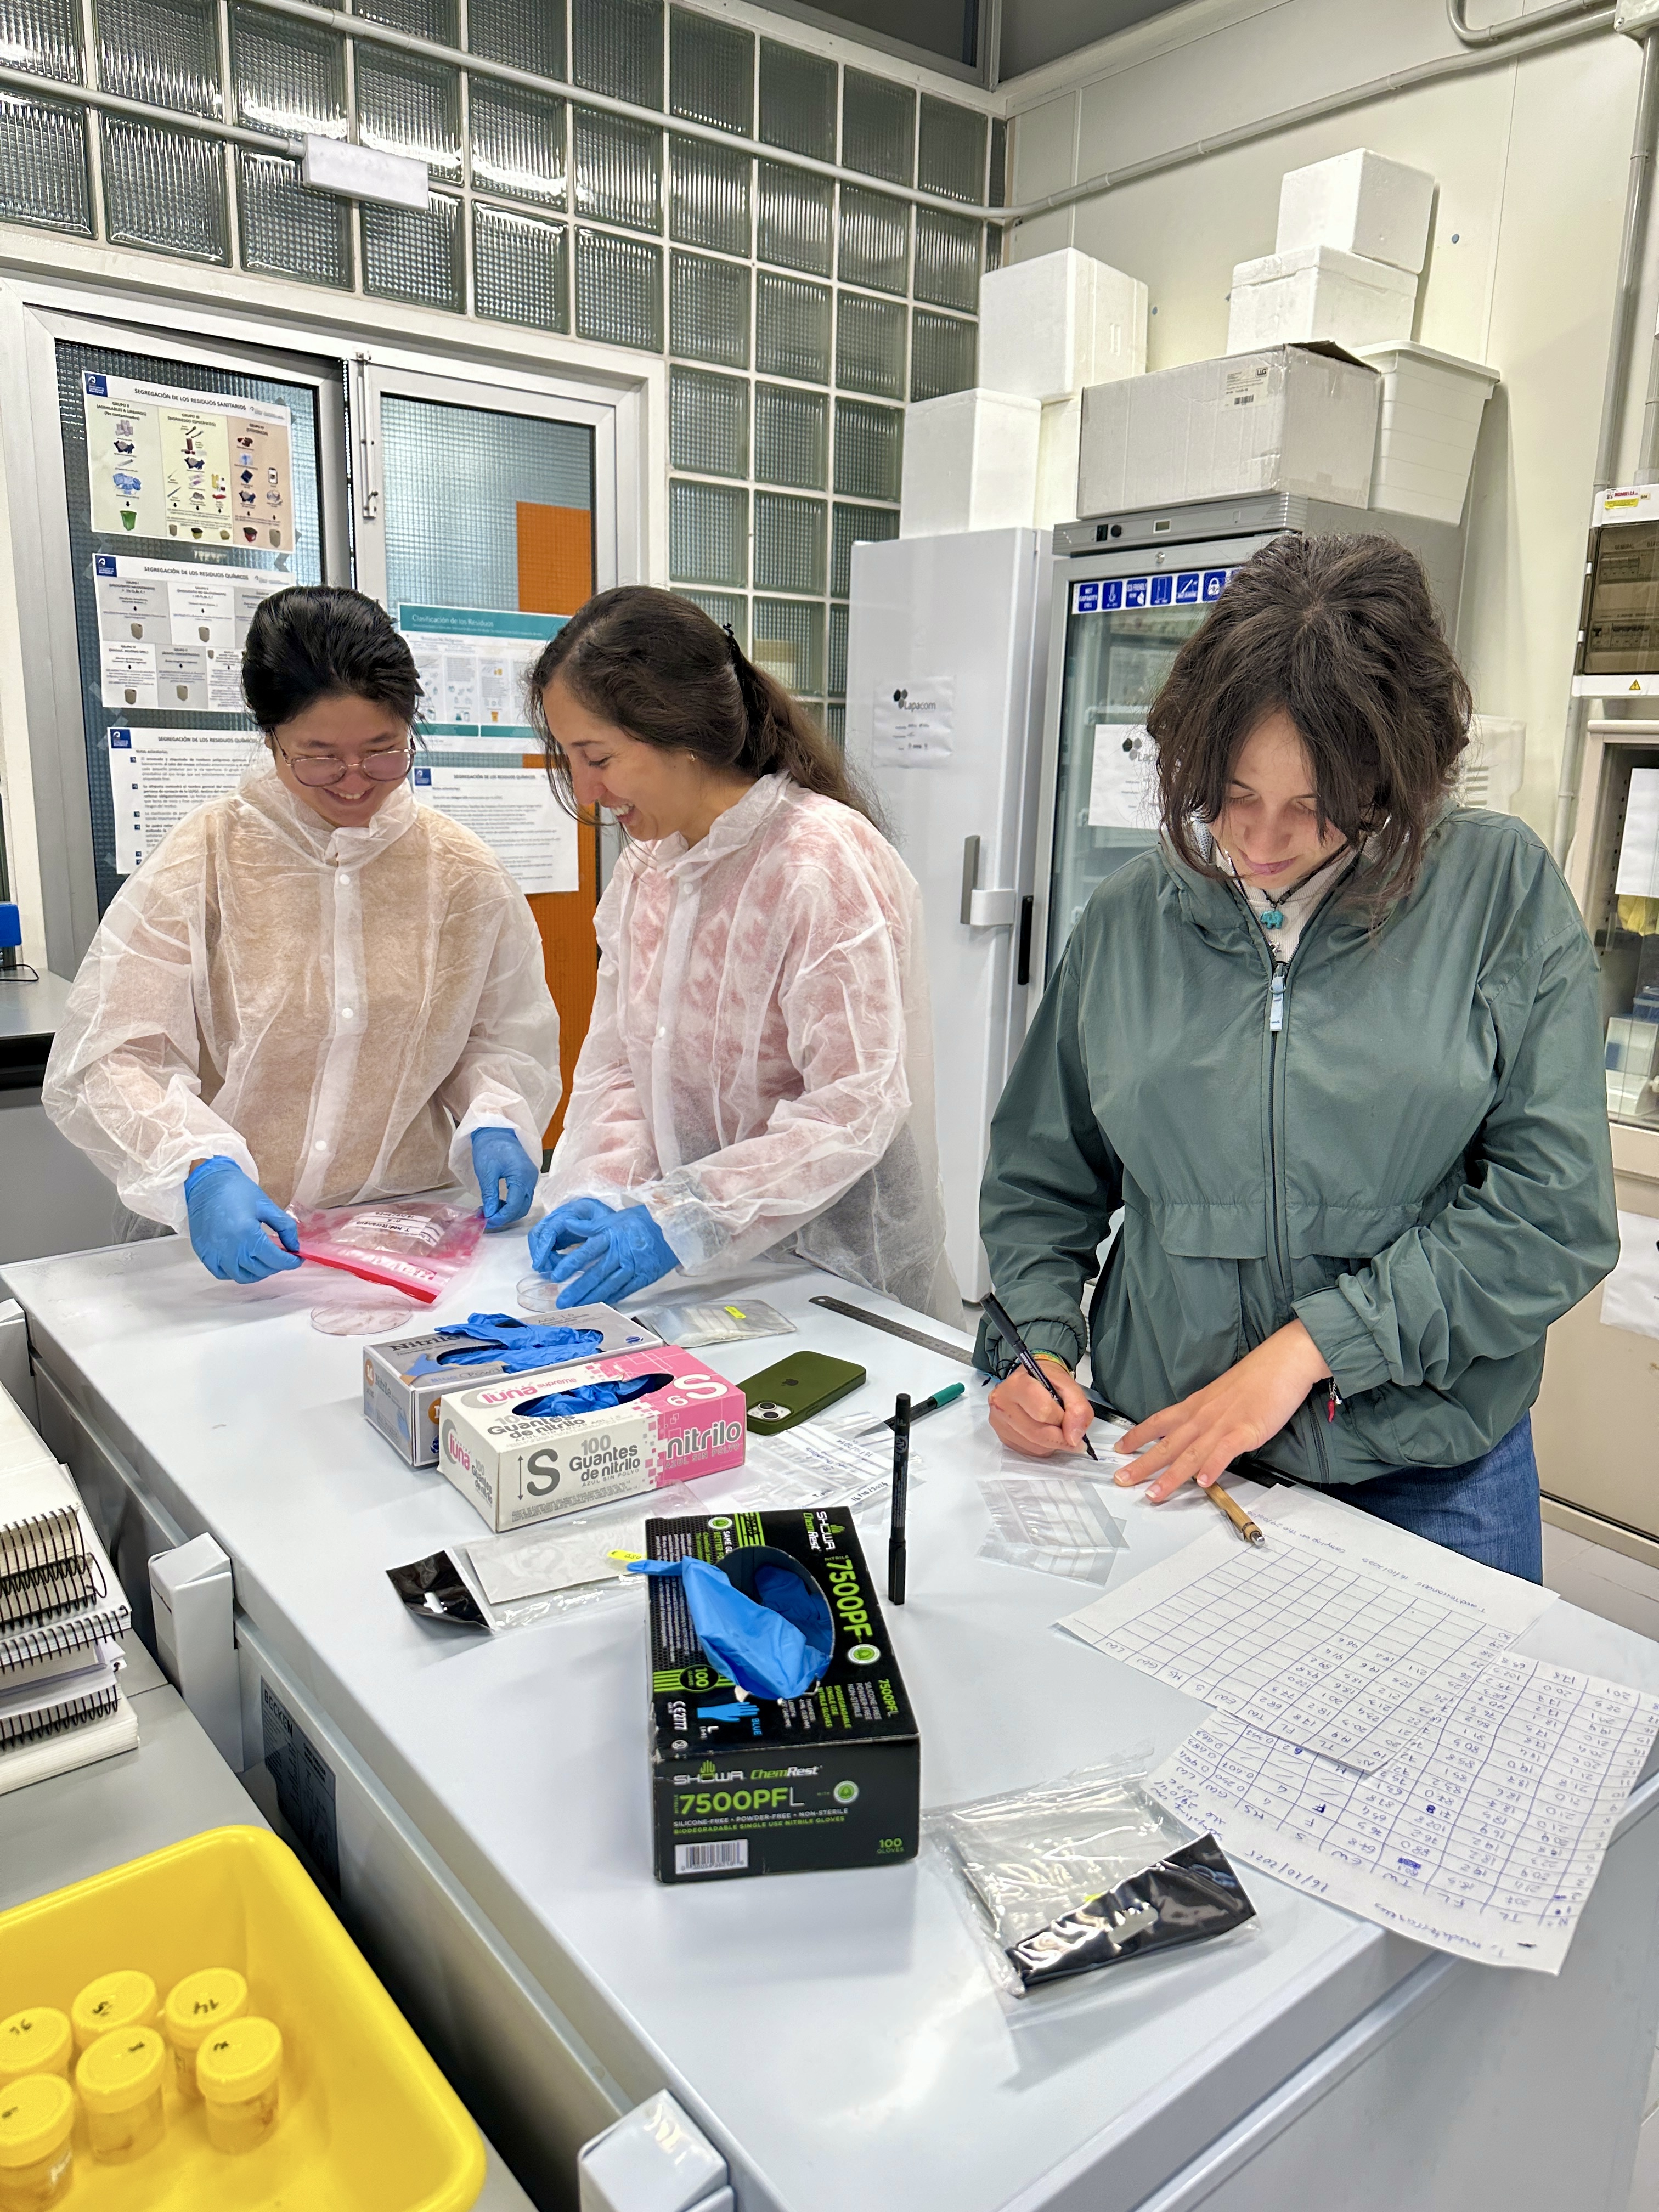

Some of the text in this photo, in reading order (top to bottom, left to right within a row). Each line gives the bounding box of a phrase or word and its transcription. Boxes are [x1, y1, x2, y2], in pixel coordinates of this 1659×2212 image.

[134, 388, 171, 399] SEGREGACIÓN
[190, 398, 216, 406] RESIDUOS
[217, 401, 246, 410] SANITARIOS
[144, 566, 180, 575] SEGREGACIÓN
[468, 618, 494, 628] Residuos
[904, 702, 936, 712] Lapacom
[390, 1335, 460, 1351] Nitrile
[481, 1378, 577, 1403] luna supreme
[667, 1374, 728, 1406] S 6
[488, 1415, 575, 1435] Guantes
[509, 1419, 585, 1438] de nitrilo
[450, 1433, 470, 1471] luna
[580, 1434, 611, 1456] 100
[666, 1419, 742, 1461] nitrilo
[569, 1444, 638, 1471] Guantes
[665, 1443, 740, 1470] AZUL SIN POLVO
[527, 1448, 560, 1496] S
[580, 1458, 641, 1482] de nitrilo
[582, 1479, 601, 1487] AZUL
[618, 1468, 639, 1477] POLVO
[713, 1531, 723, 1551] BETTER
[723, 1531, 732, 1545] SAME
[803, 1512, 821, 1551] ChemRest
[816, 1511, 836, 1551] SHOWA
[826, 1559, 873, 1637] 7500PF
[695, 1667, 710, 1687] 100
[1167, 1671, 1182, 1680] MS
[817, 1687, 833, 1728] NITRILE GLOVES
[826, 1686, 839, 1716] SINGLE USE
[834, 1685, 851, 1729] BIODEGRADABLE
[847, 1684, 862, 1717] NON-STERILE
[856, 1683, 872, 1720] POWDER-FREE
[865, 1681, 883, 1720] SILICONE-FREE
[878, 1679, 899, 1717] 7500PFL
[264, 1689, 293, 1738] BECKEN
[752, 1718, 762, 1736] BLUE
[673, 1765, 820, 1786] SHOWA ChemRest
[680, 1786, 805, 1815] 7500PFL
[673, 1808, 848, 1828] SILICONE-FREE POWDER-FREE NON-STERILE
[673, 1824, 737, 1835] BIODEGRADABLE
[878, 1837, 903, 1848] 100
